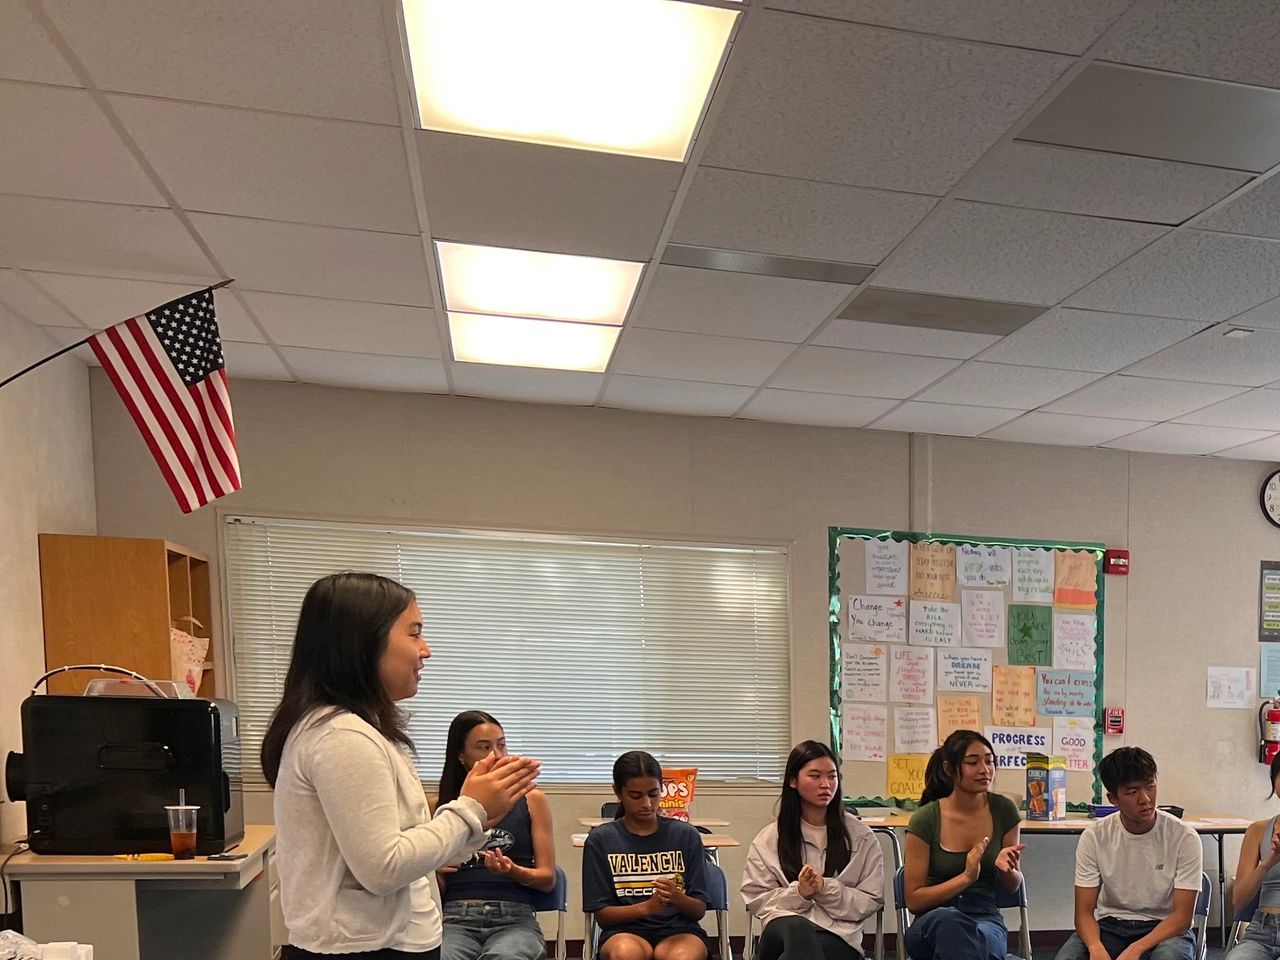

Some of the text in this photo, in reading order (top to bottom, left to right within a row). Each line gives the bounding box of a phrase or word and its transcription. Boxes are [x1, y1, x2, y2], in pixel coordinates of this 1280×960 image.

[853, 598, 882, 616] Change
[851, 614, 893, 630] You Change
[895, 651, 911, 660] LIFE
[951, 661, 980, 670] DREAM
[949, 680, 973, 688] NEVER
[1041, 673, 1053, 685] You
[1054, 673, 1071, 686] can't
[992, 732, 1045, 746] PROGRESS
[1061, 736, 1086, 747] GOOD
[893, 759, 908, 770] SET
[1069, 759, 1089, 768] TTER
[908, 769, 925, 780] YOU
[890, 783, 924, 794] GOALS
[608, 851, 685, 875] VALENCIA
[616, 888, 656, 897] SOCC
